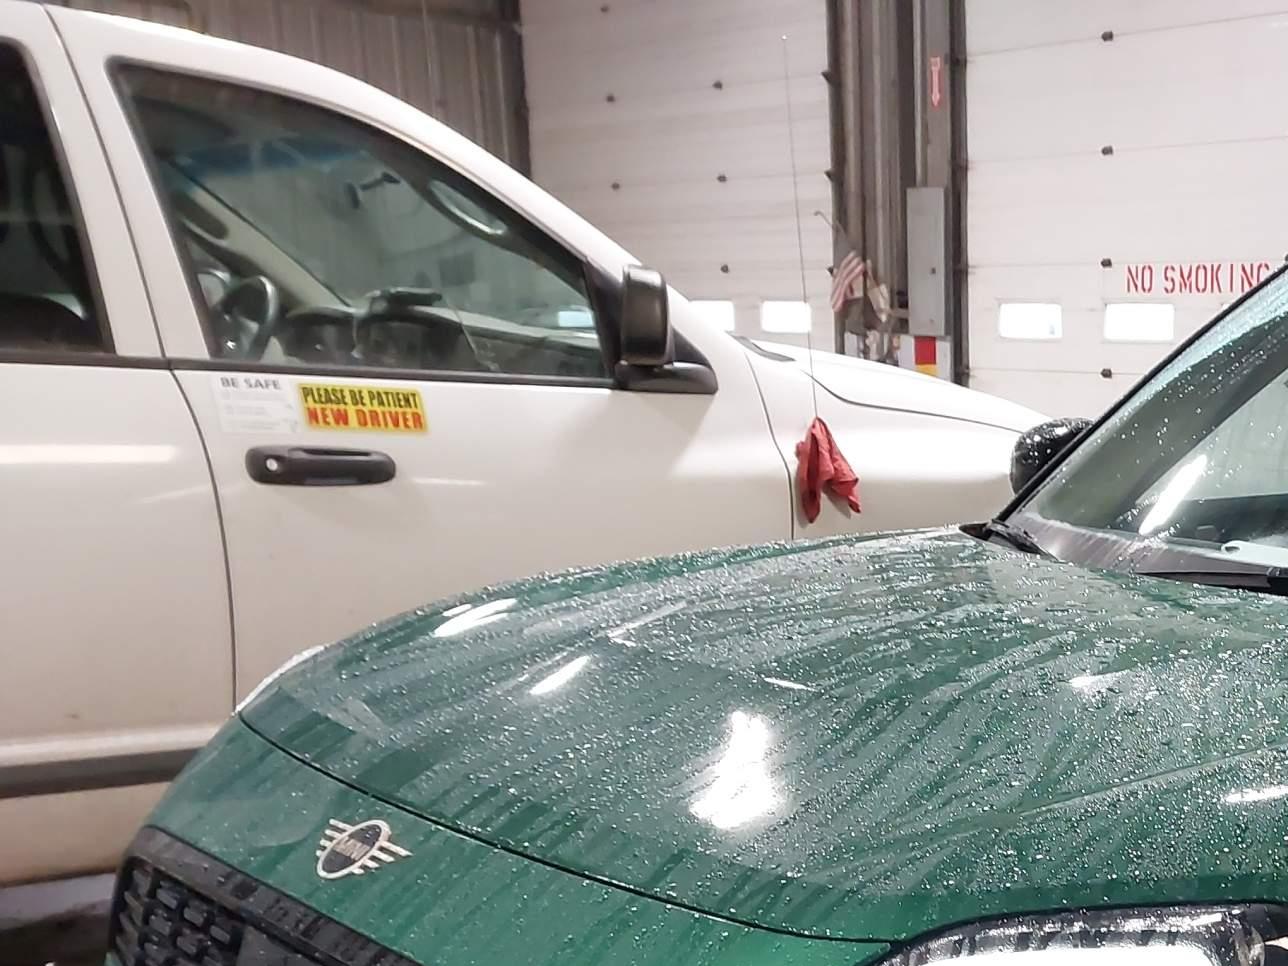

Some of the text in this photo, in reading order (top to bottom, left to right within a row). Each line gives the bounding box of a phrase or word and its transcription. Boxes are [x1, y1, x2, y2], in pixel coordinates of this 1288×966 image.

[1126, 263, 1153, 294] NO
[220, 376, 282, 390] BE SAFE
[301, 386, 419, 409] PLEASE BE PATIENT
[306, 406, 349, 426] NEW
[355, 409, 425, 430] DRIVER
